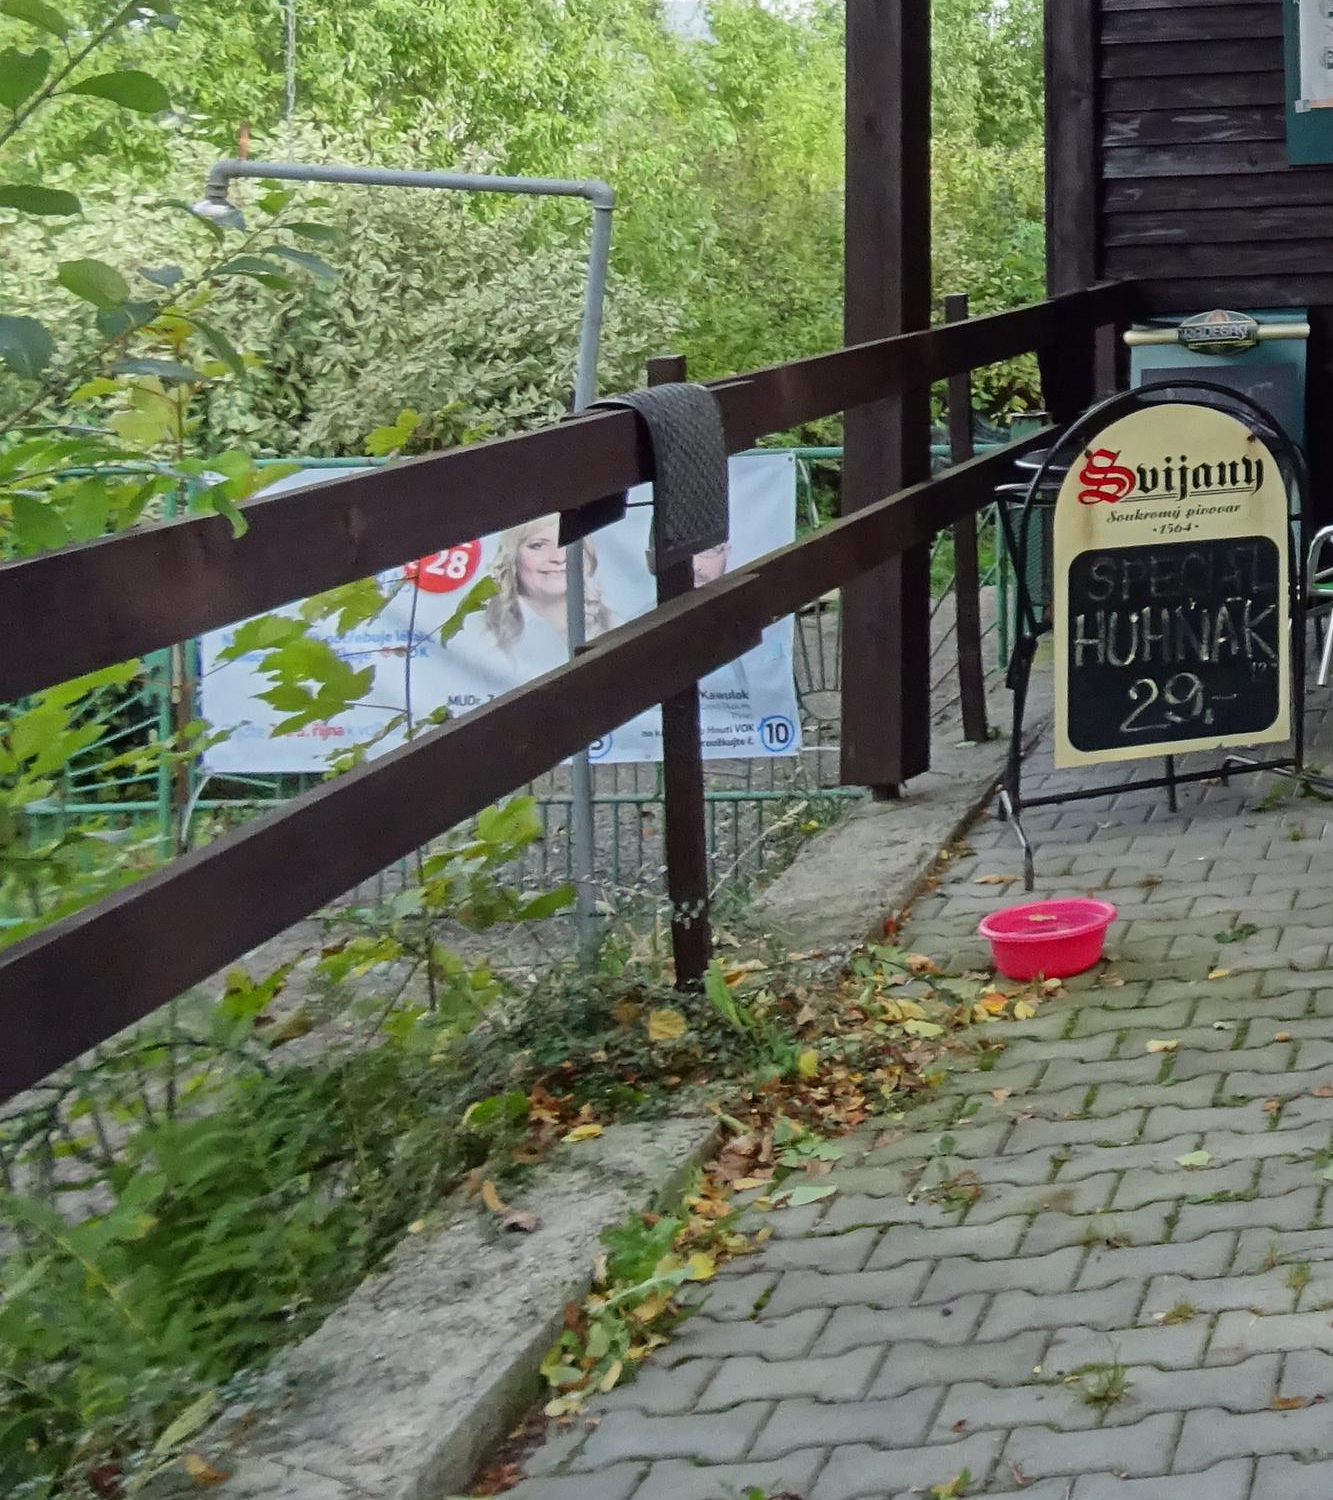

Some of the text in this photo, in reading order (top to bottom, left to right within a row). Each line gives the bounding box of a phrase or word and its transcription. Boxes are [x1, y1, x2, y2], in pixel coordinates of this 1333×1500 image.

[1183, 323, 1248, 341] RADEGAST
[1075, 448, 1264, 505] Svijany
[1105, 502, 1240, 524] Soukromý pivovar
[734, 724, 755, 733] VOK
[766, 722, 789, 744] 10
